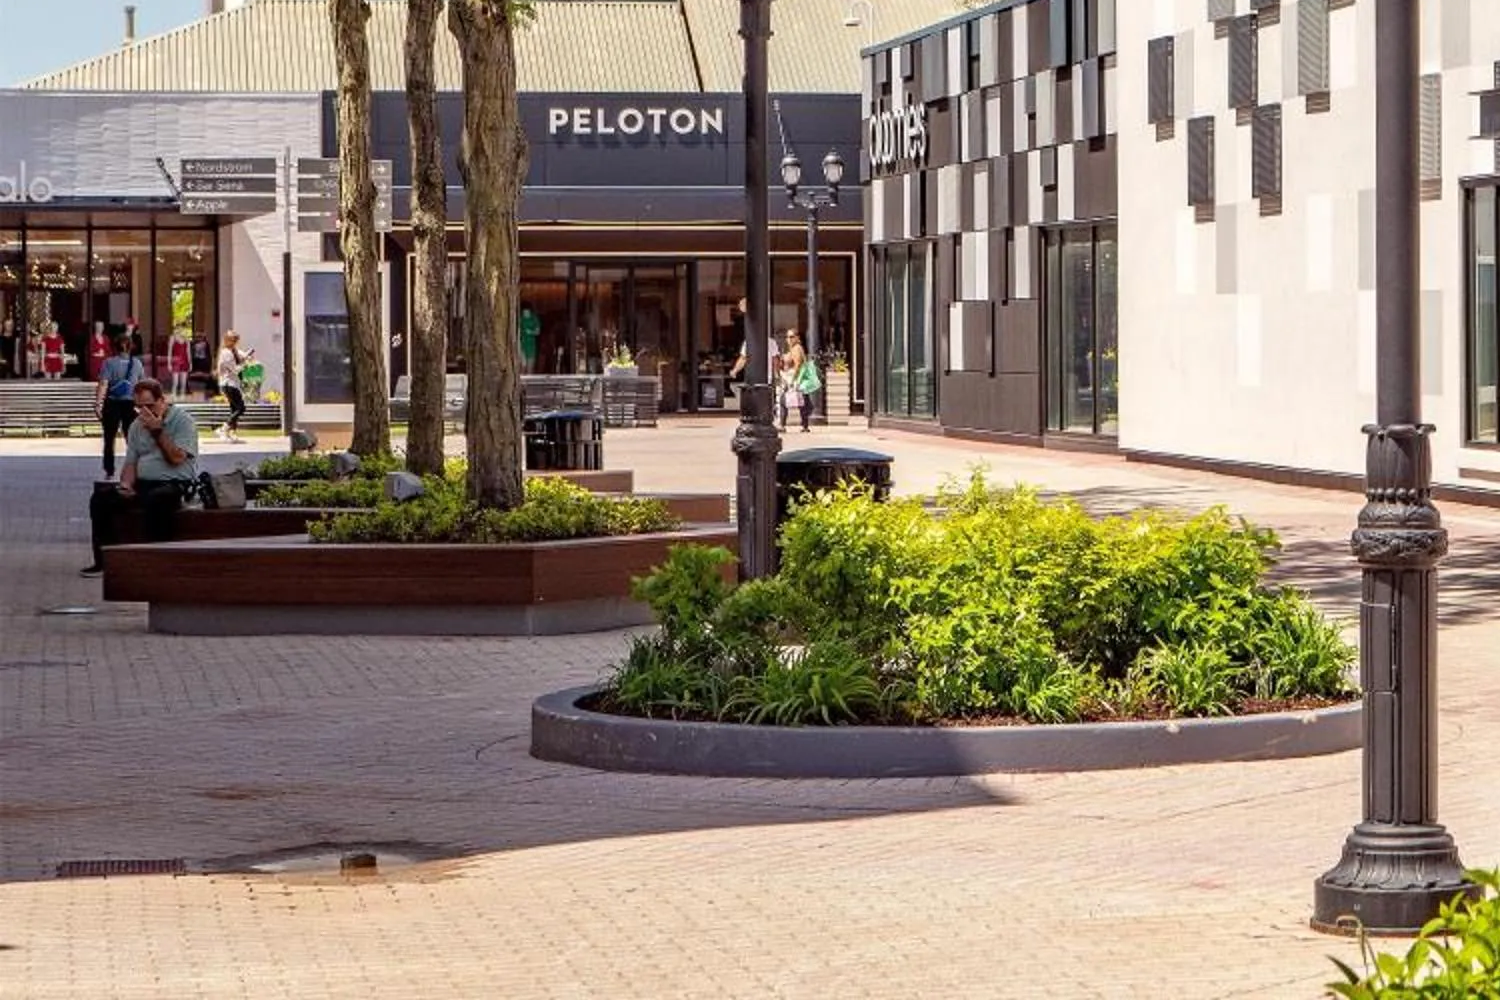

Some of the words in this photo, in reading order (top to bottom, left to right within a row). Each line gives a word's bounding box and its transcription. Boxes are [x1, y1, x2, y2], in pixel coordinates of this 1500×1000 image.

[549, 107, 723, 135] PELOTON
[196, 162, 253, 172] Nordstrom
[0, 160, 52, 202] alo
[196, 200, 228, 212] Apple
